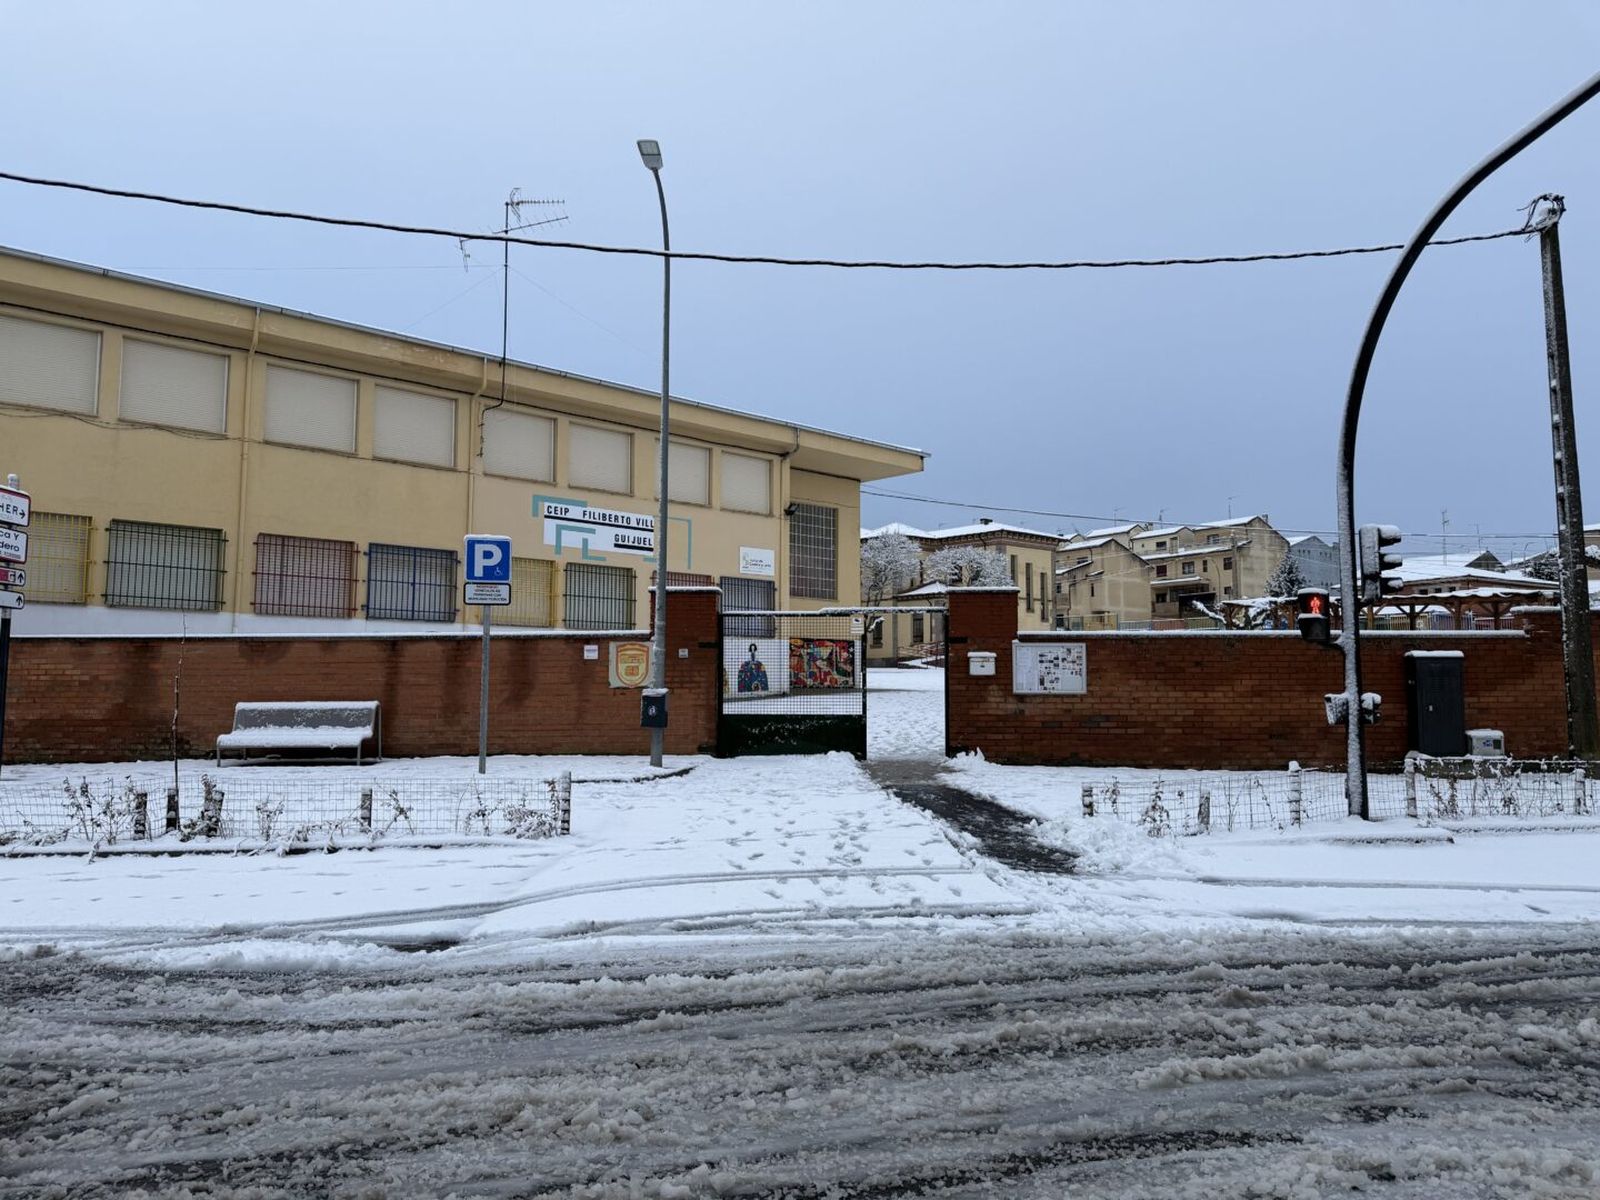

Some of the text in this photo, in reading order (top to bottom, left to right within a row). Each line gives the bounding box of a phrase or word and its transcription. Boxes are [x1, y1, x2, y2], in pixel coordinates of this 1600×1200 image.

[546, 505, 570, 516] CEIP
[582, 510, 631, 525] FILIBERTO
[614, 533, 653, 546] GUIJUEL
[474, 543, 503, 577] P
